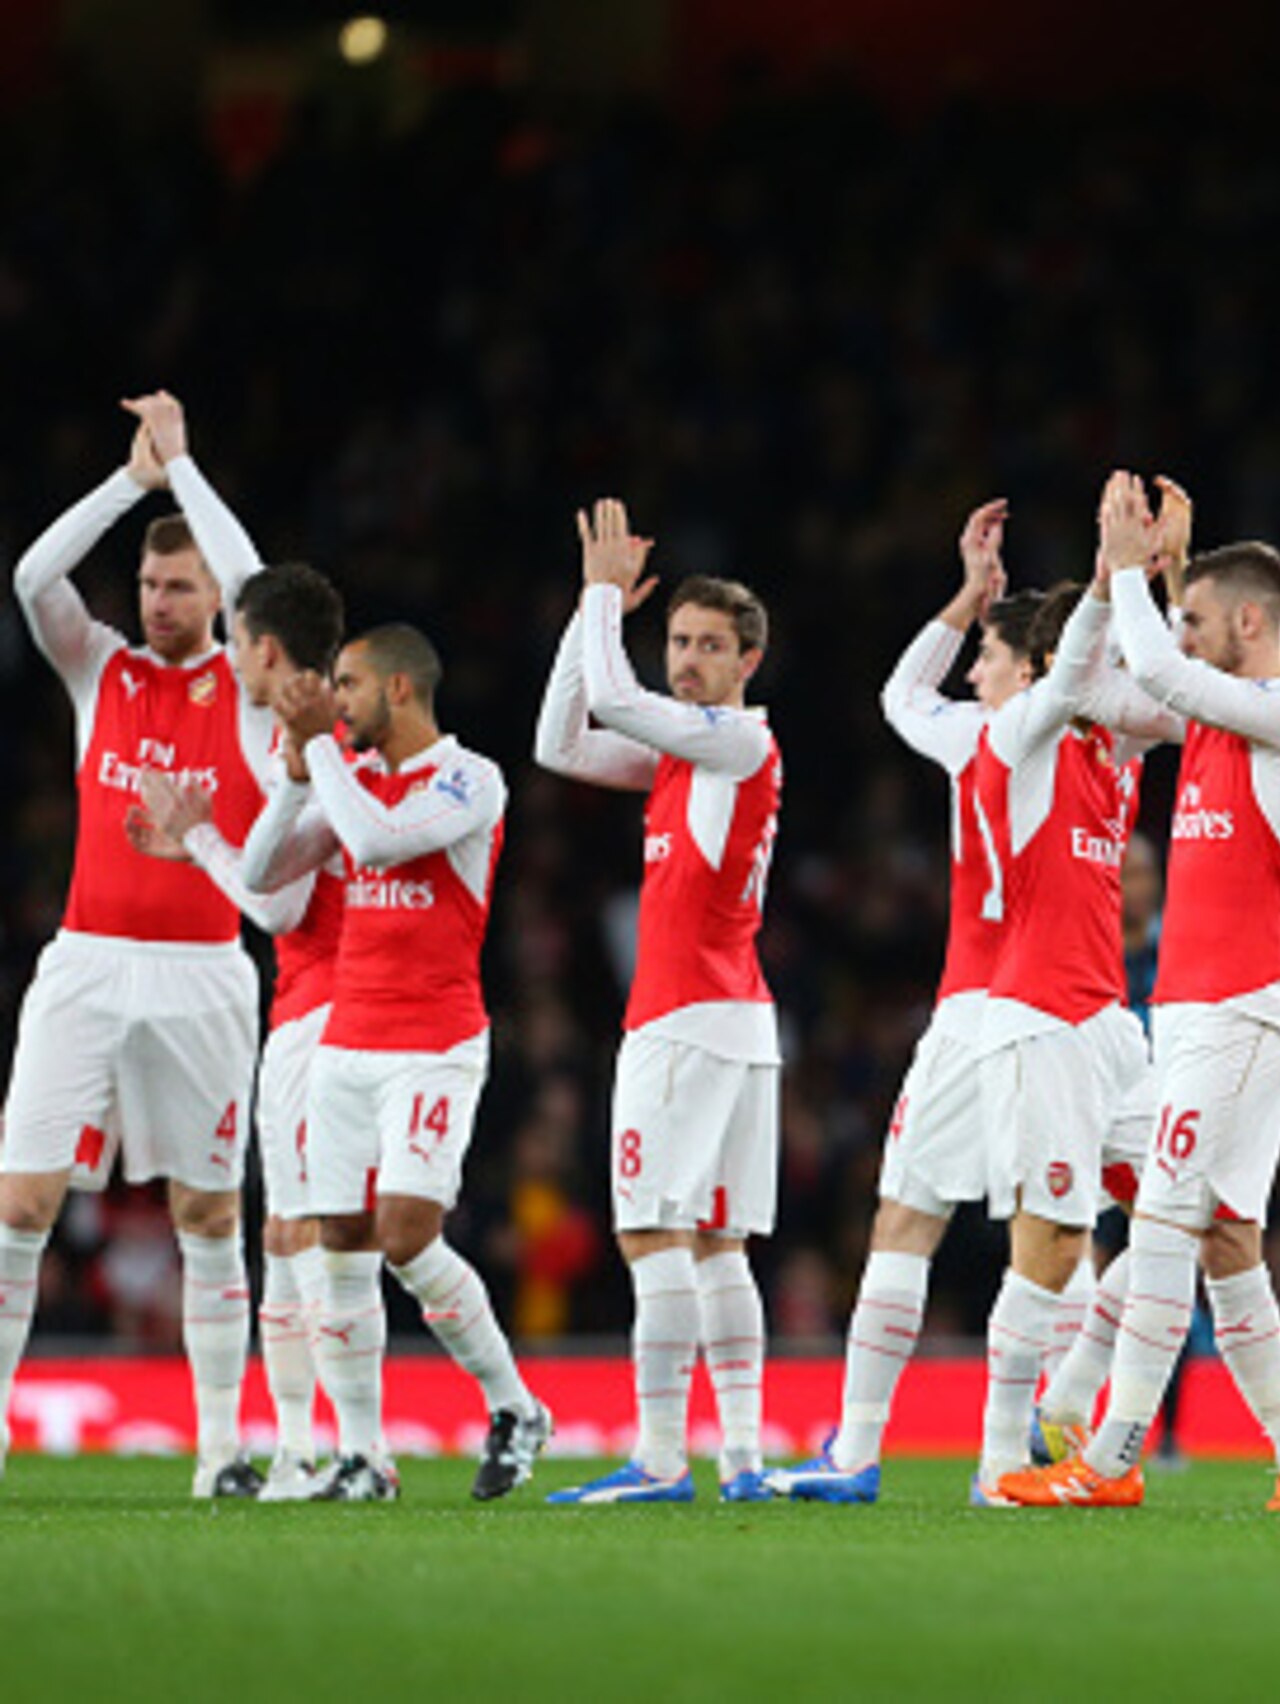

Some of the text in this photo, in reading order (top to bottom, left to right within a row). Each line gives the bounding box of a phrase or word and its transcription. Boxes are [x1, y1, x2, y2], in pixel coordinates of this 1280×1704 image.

[214, 1099, 237, 1148] 4
[408, 1092, 451, 1145] 14
[1156, 1103, 1201, 1161] 16
